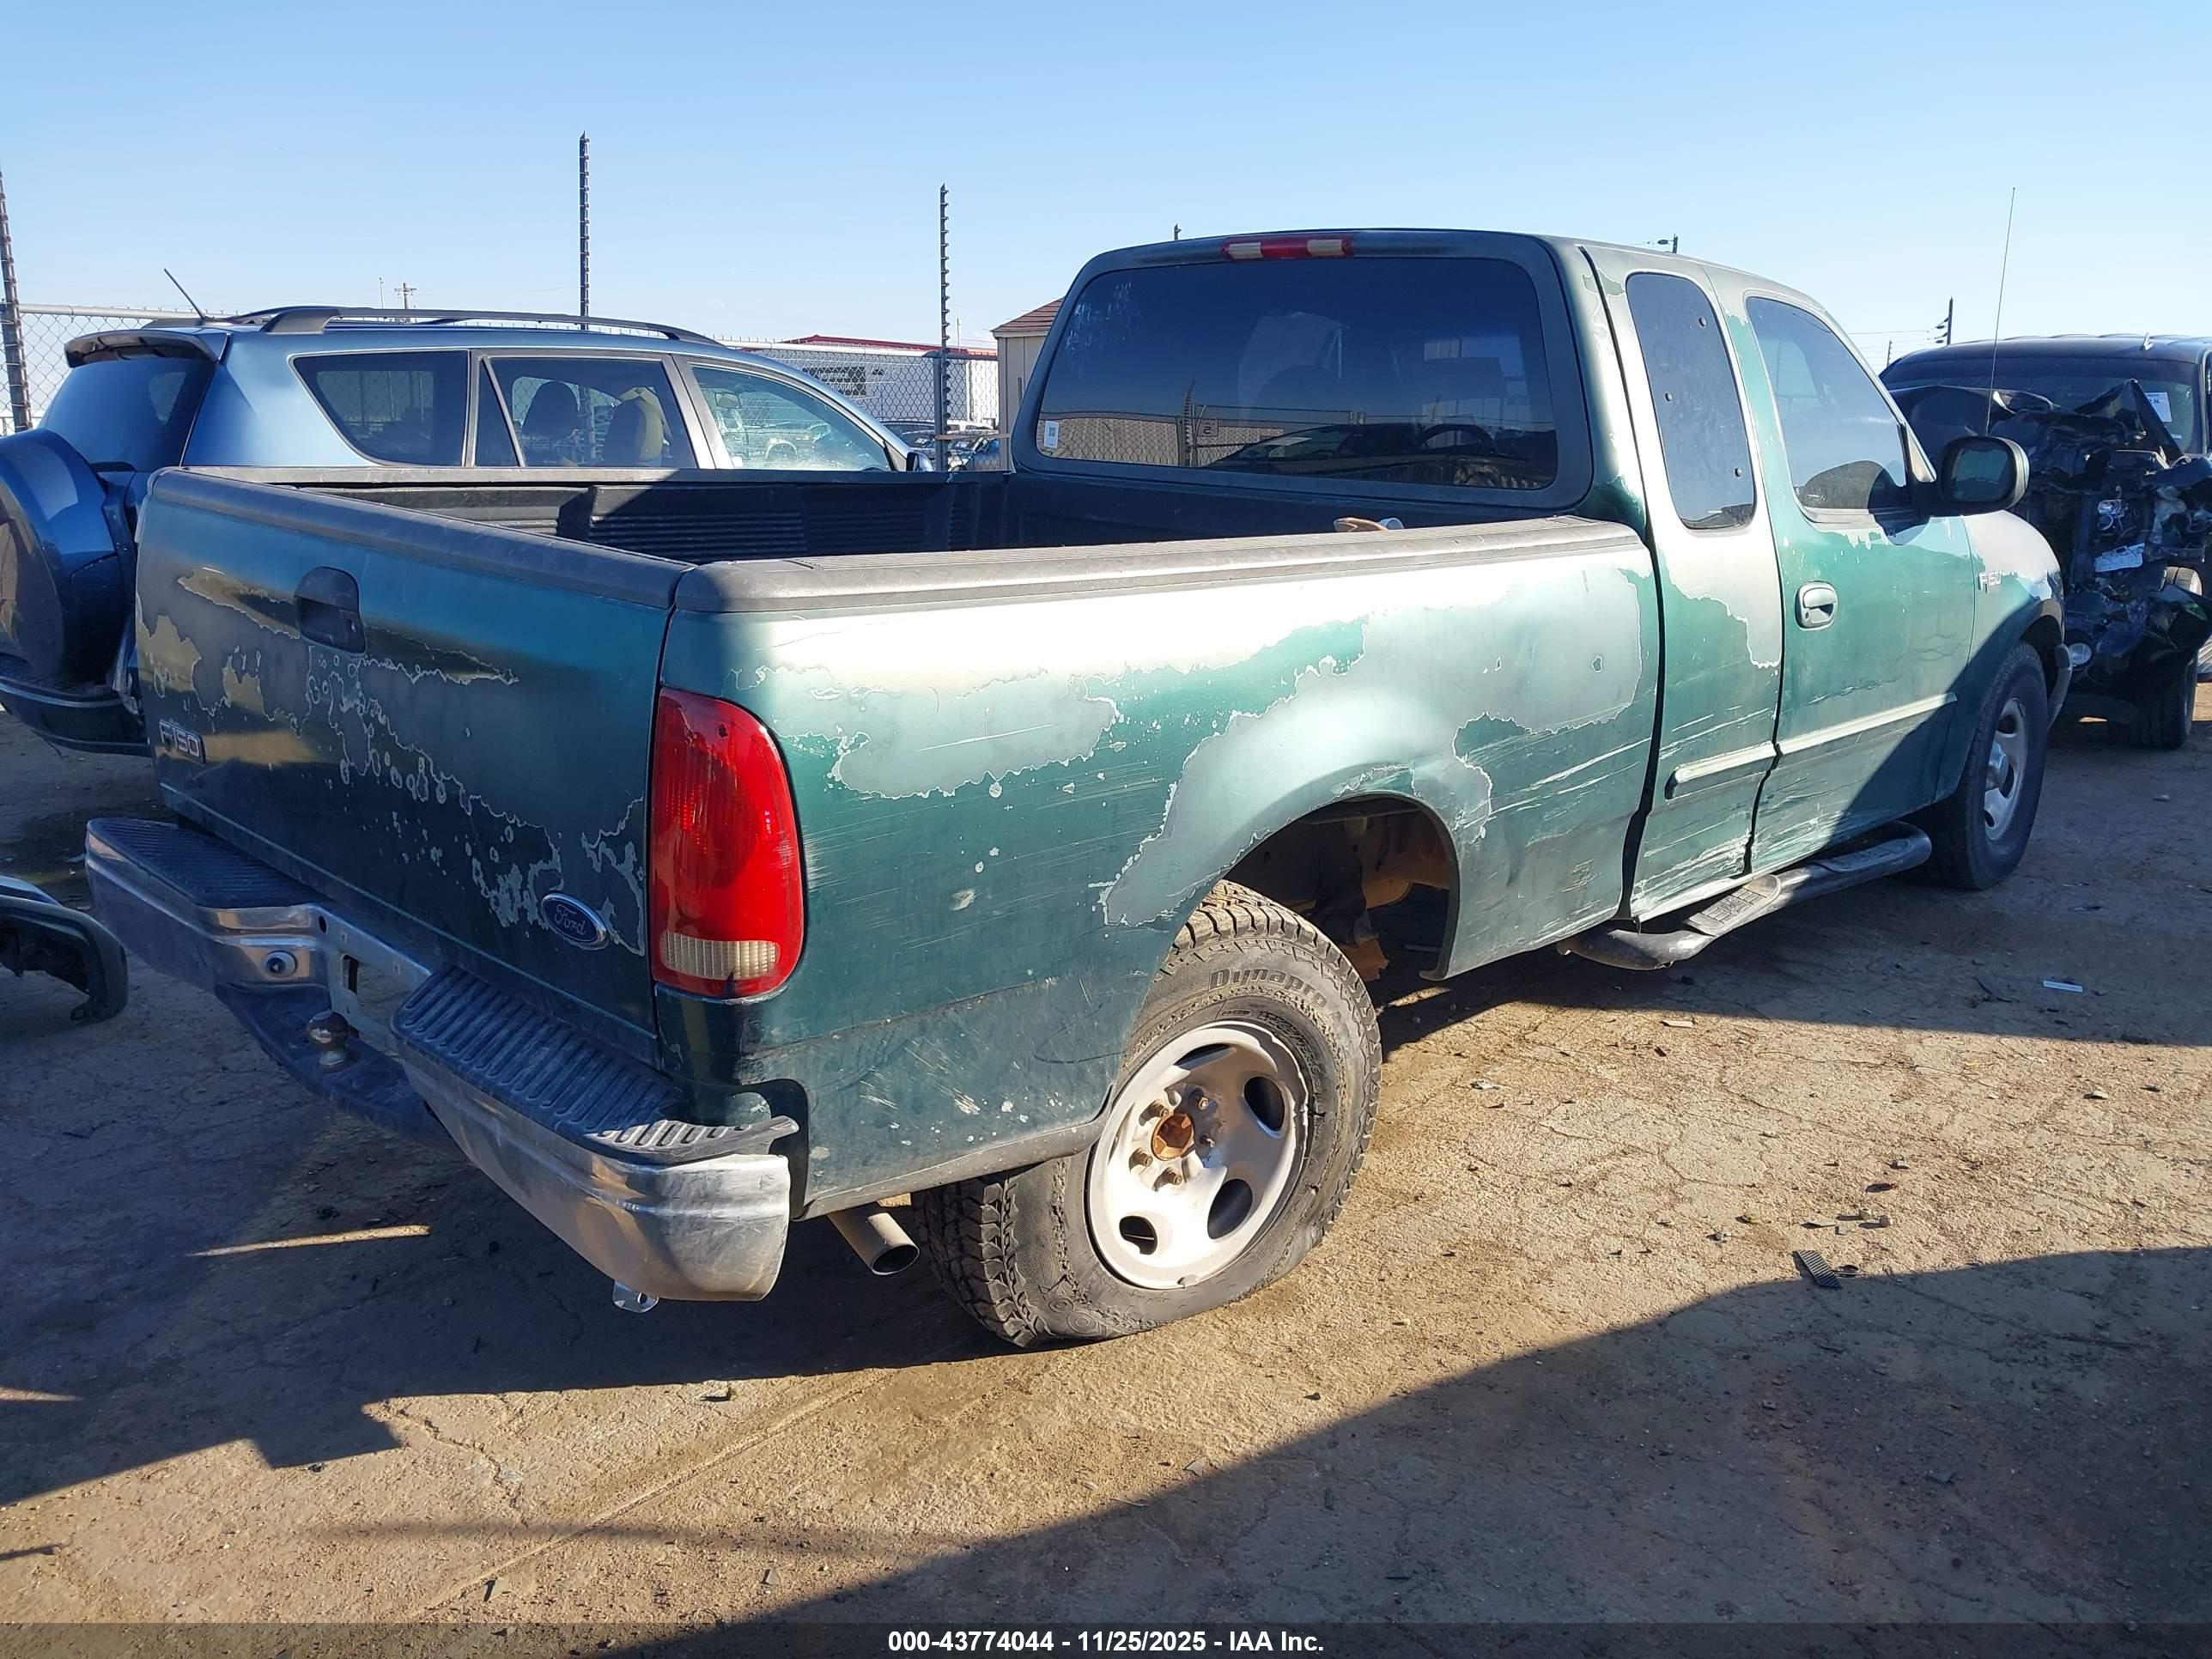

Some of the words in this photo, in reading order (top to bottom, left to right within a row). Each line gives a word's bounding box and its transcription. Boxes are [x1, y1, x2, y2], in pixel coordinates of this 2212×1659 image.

[159, 721, 199, 757] F150
[554, 903, 586, 936] Ford
[1209, 967, 1328, 1009] Dynapro
